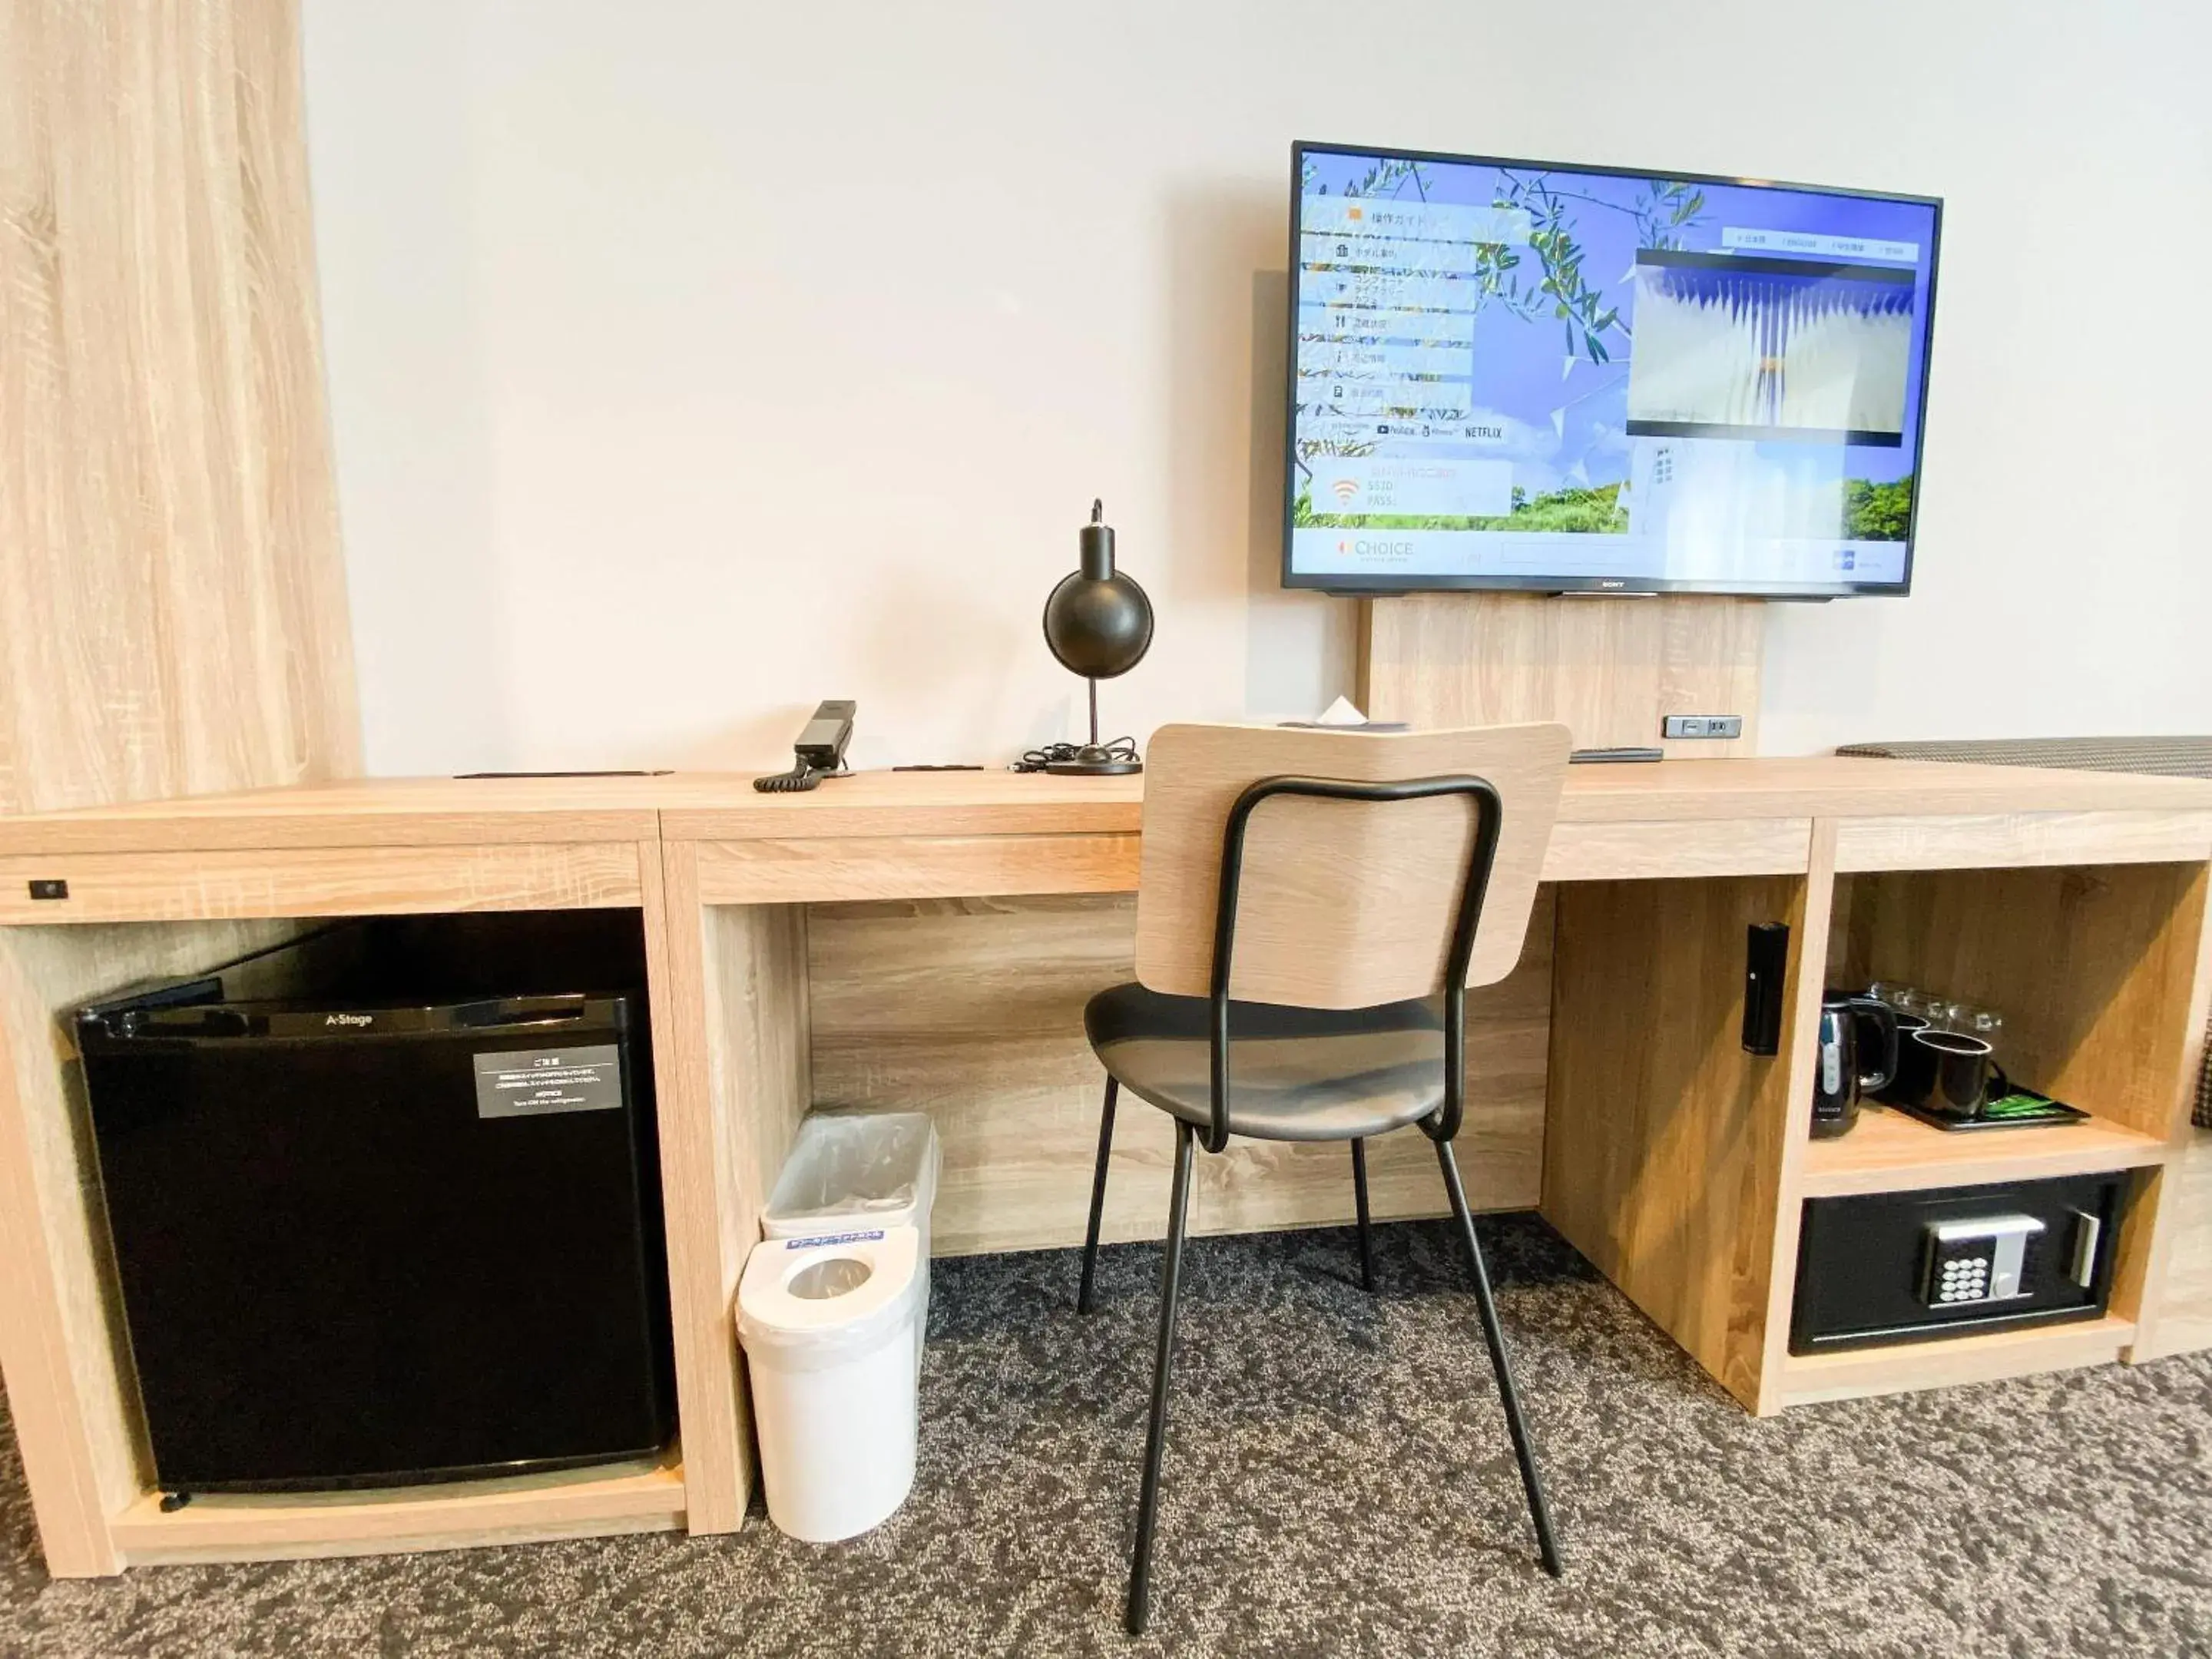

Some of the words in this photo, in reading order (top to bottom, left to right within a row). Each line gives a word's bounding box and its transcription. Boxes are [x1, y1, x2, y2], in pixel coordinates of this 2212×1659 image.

[1465, 427, 1502, 439] NETFLIX
[1355, 541, 1414, 555] CHOICE
[325, 1014, 373, 1028] A-Stage
